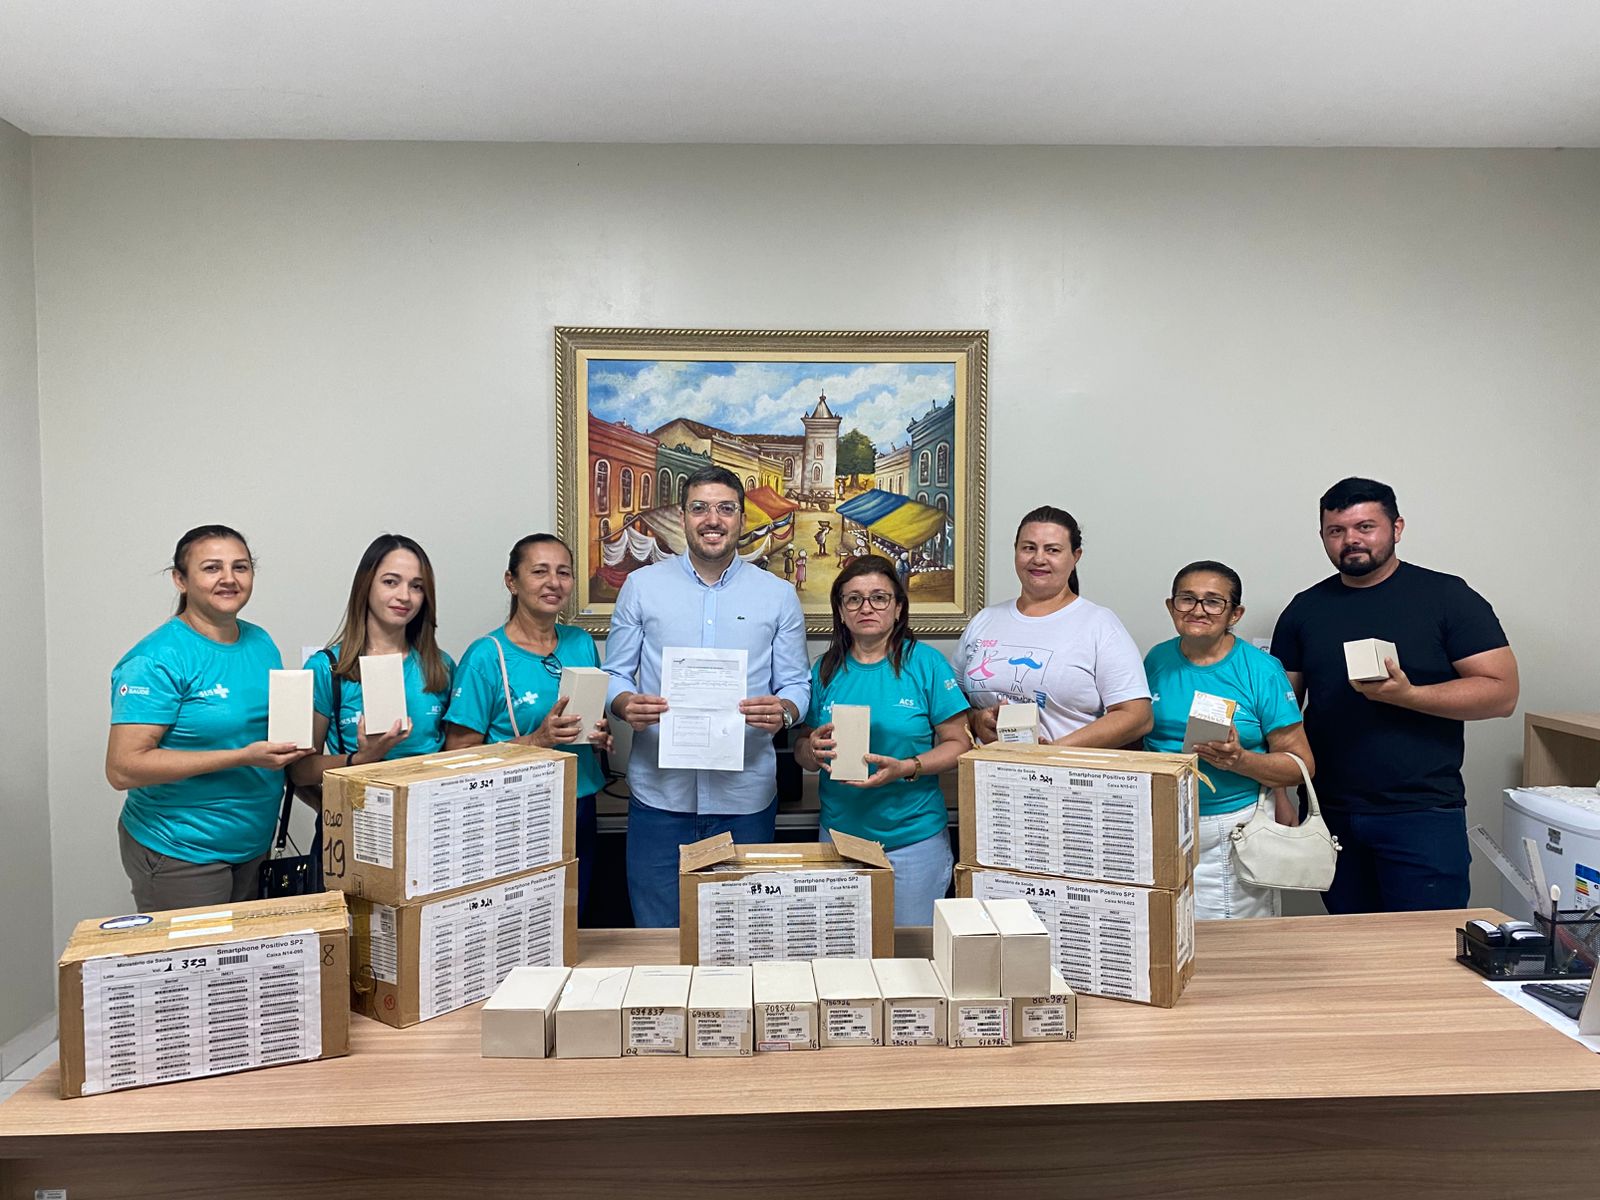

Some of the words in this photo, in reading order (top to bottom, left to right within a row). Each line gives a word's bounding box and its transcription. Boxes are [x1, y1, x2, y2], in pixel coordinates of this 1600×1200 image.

[1068, 771, 1101, 779] Smartphone
[323, 836, 346, 879] 19
[1066, 885, 1099, 893] Smartphone
[1100, 888, 1122, 896] Positivo
[217, 945, 259, 956] Smartphone
[260, 942, 288, 950] Positivo
[116, 960, 145, 968] Ministério
[181, 958, 207, 969] 329
